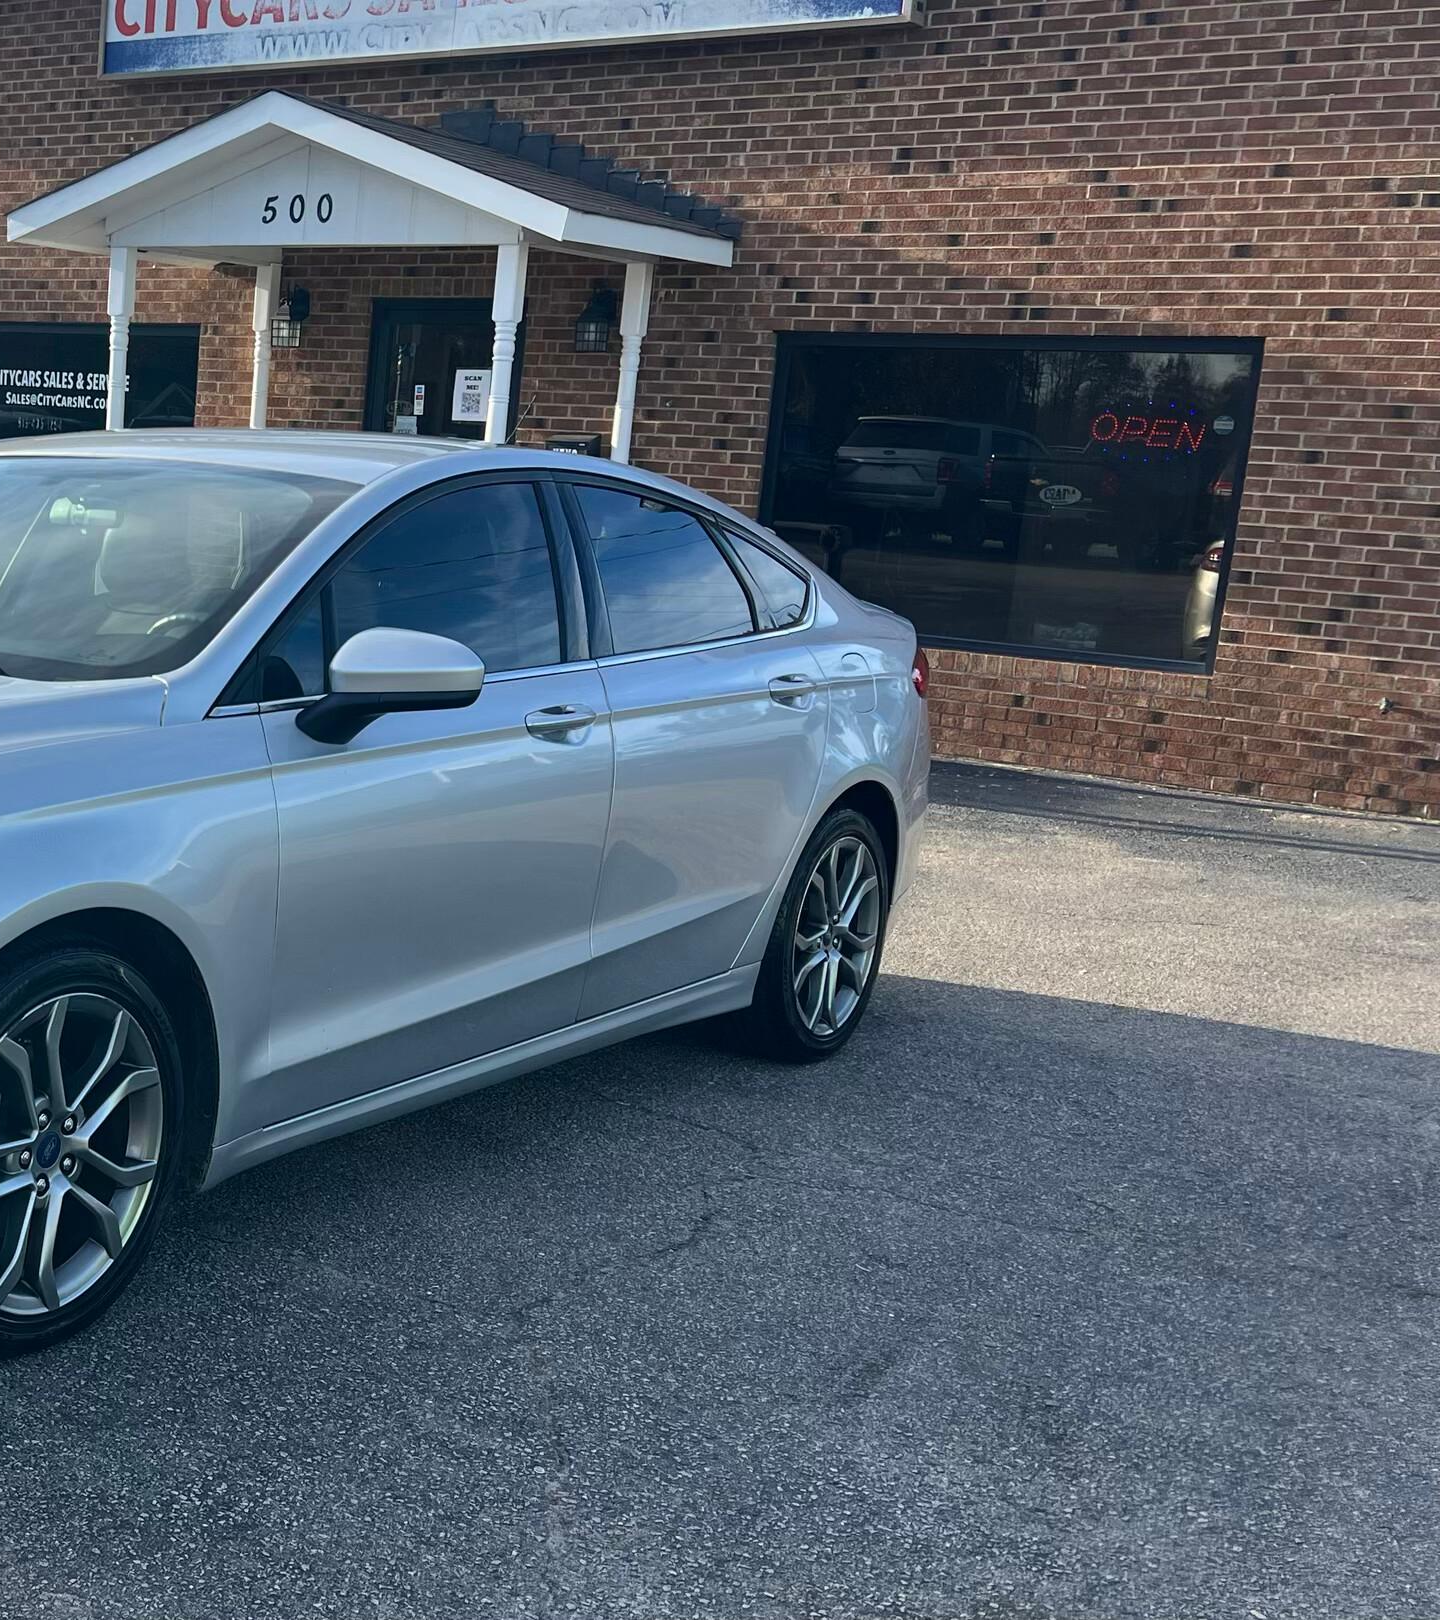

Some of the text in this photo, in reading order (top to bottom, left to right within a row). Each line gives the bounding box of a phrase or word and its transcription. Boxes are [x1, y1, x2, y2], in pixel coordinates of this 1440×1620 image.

[262, 193, 333, 224] 500
[44, 372, 74, 390] SALES
[76, 375, 85, 390] &
[86, 374, 131, 392] SERVE
[5, 391, 108, 410] SALES@CITYCARSNC.CO
[1091, 412, 1208, 452] OPEN
